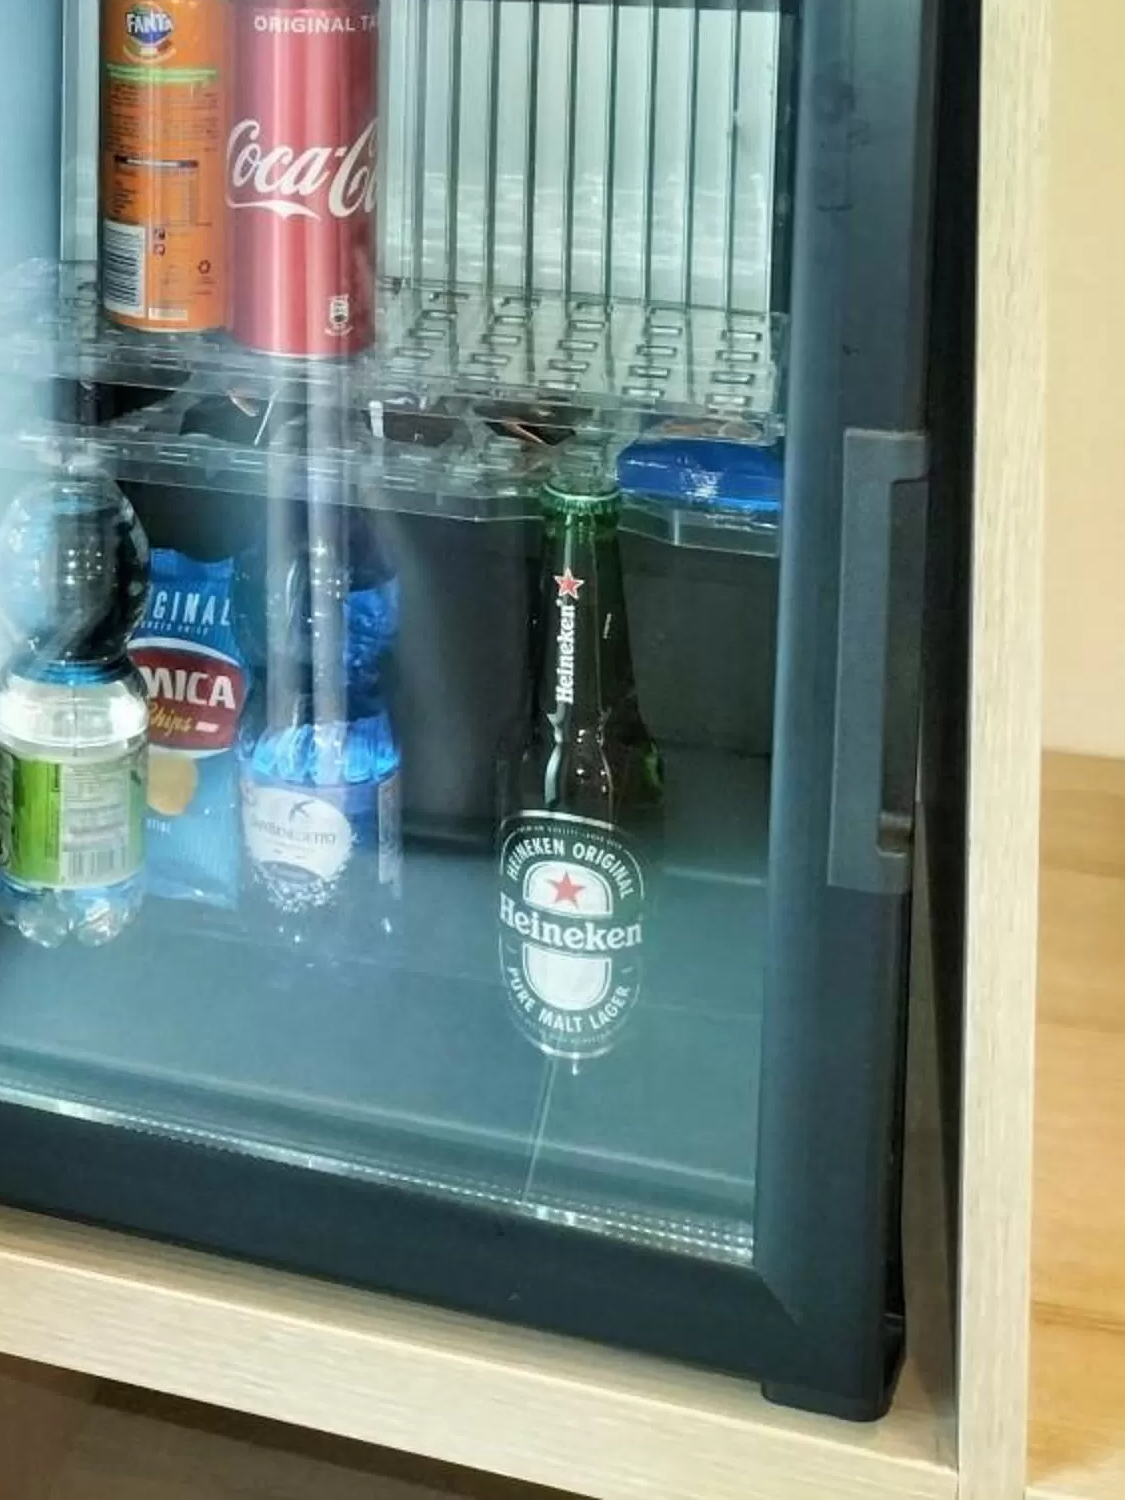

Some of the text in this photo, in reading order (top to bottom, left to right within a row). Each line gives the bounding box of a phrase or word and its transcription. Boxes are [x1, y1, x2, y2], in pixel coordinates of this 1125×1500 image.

[126, 10, 174, 33] FANTA
[254, 14, 356, 33] ORIGINAL
[151, 590, 232, 626] GINAL
[555, 604, 576, 704] Heineken
[138, 665, 237, 710] MICA
[506, 837, 566, 882] HEINEKEN
[572, 842, 635, 900] ORIGINAL
[499, 891, 643, 951] Heineken
[538, 1007, 583, 1033] MALT
[588, 986, 630, 1030] LAGER
